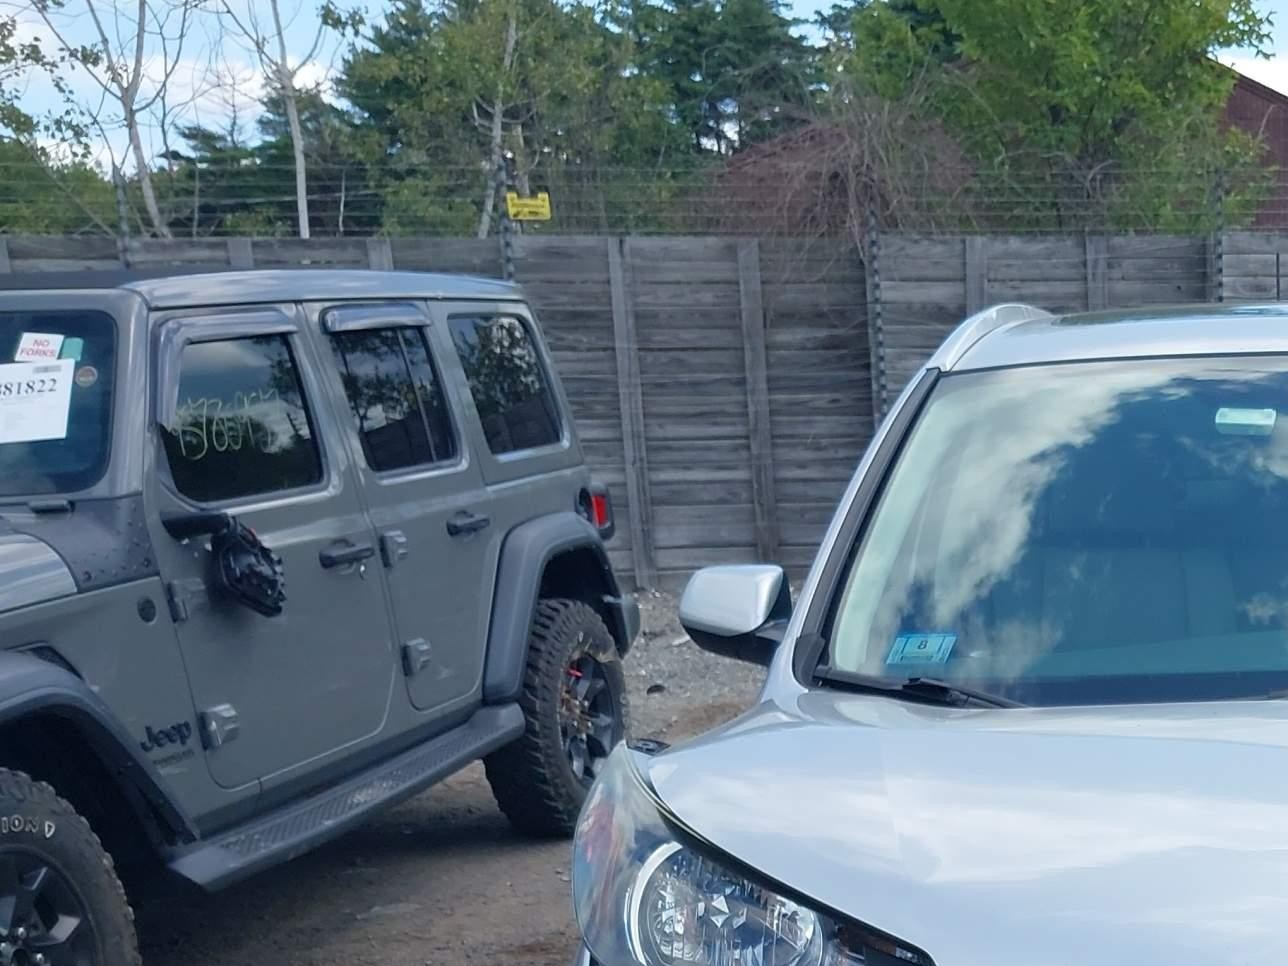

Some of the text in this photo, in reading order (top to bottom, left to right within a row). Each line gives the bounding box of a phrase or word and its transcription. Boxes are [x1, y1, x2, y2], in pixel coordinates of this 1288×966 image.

[32, 339, 50, 347] NO
[19, 348, 56, 357] FORKS
[0, 378, 57, 397] 81822
[140, 720, 192, 753] Jeep
